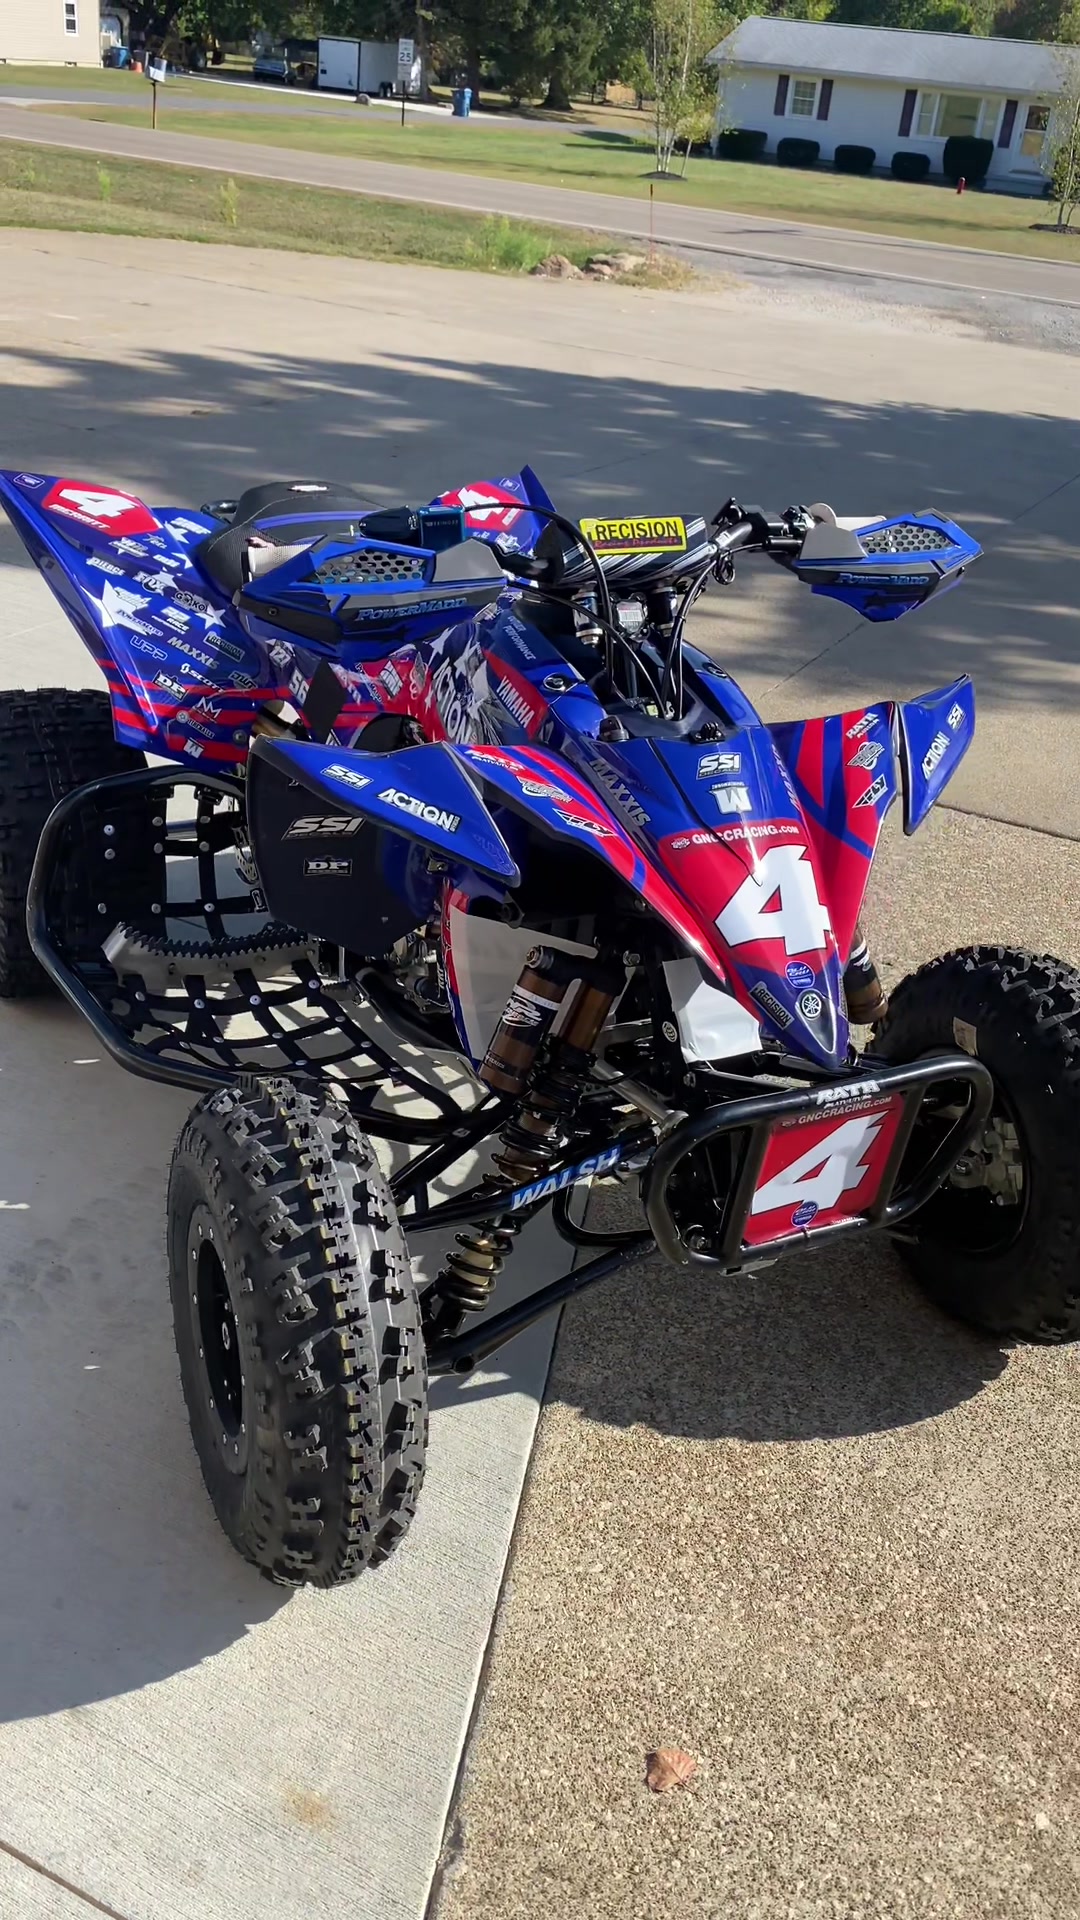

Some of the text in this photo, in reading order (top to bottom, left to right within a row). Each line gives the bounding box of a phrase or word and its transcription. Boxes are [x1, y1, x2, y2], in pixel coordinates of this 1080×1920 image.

[400, 52, 411, 62] 25
[59, 488, 140, 518] 4
[86, 556, 126, 576] PIERCE
[132, 571, 165, 596] FOX
[130, 635, 168, 661] UPP
[167, 636, 220, 669] MAXXIS
[503, 626, 536, 660] PERFORMANCE
[496, 676, 535, 728] YAMAHA
[846, 712, 878, 739] RATH
[947, 704, 965, 729] SSI
[326, 765, 371, 787] SSI
[700, 754, 740, 773] SSI
[589, 759, 651, 827] MAXXIS
[377, 788, 455, 832] ACTION
[291, 817, 363, 834] SSI
[692, 824, 800, 845] GNCCRACING.COM
[714, 844, 831, 956] 4
[816, 1080, 880, 1105] RATH
[798, 1097, 892, 1124] GNCCRACING.COM
[751, 1110, 889, 1216] 4
[511, 1148, 620, 1211] WALSH
